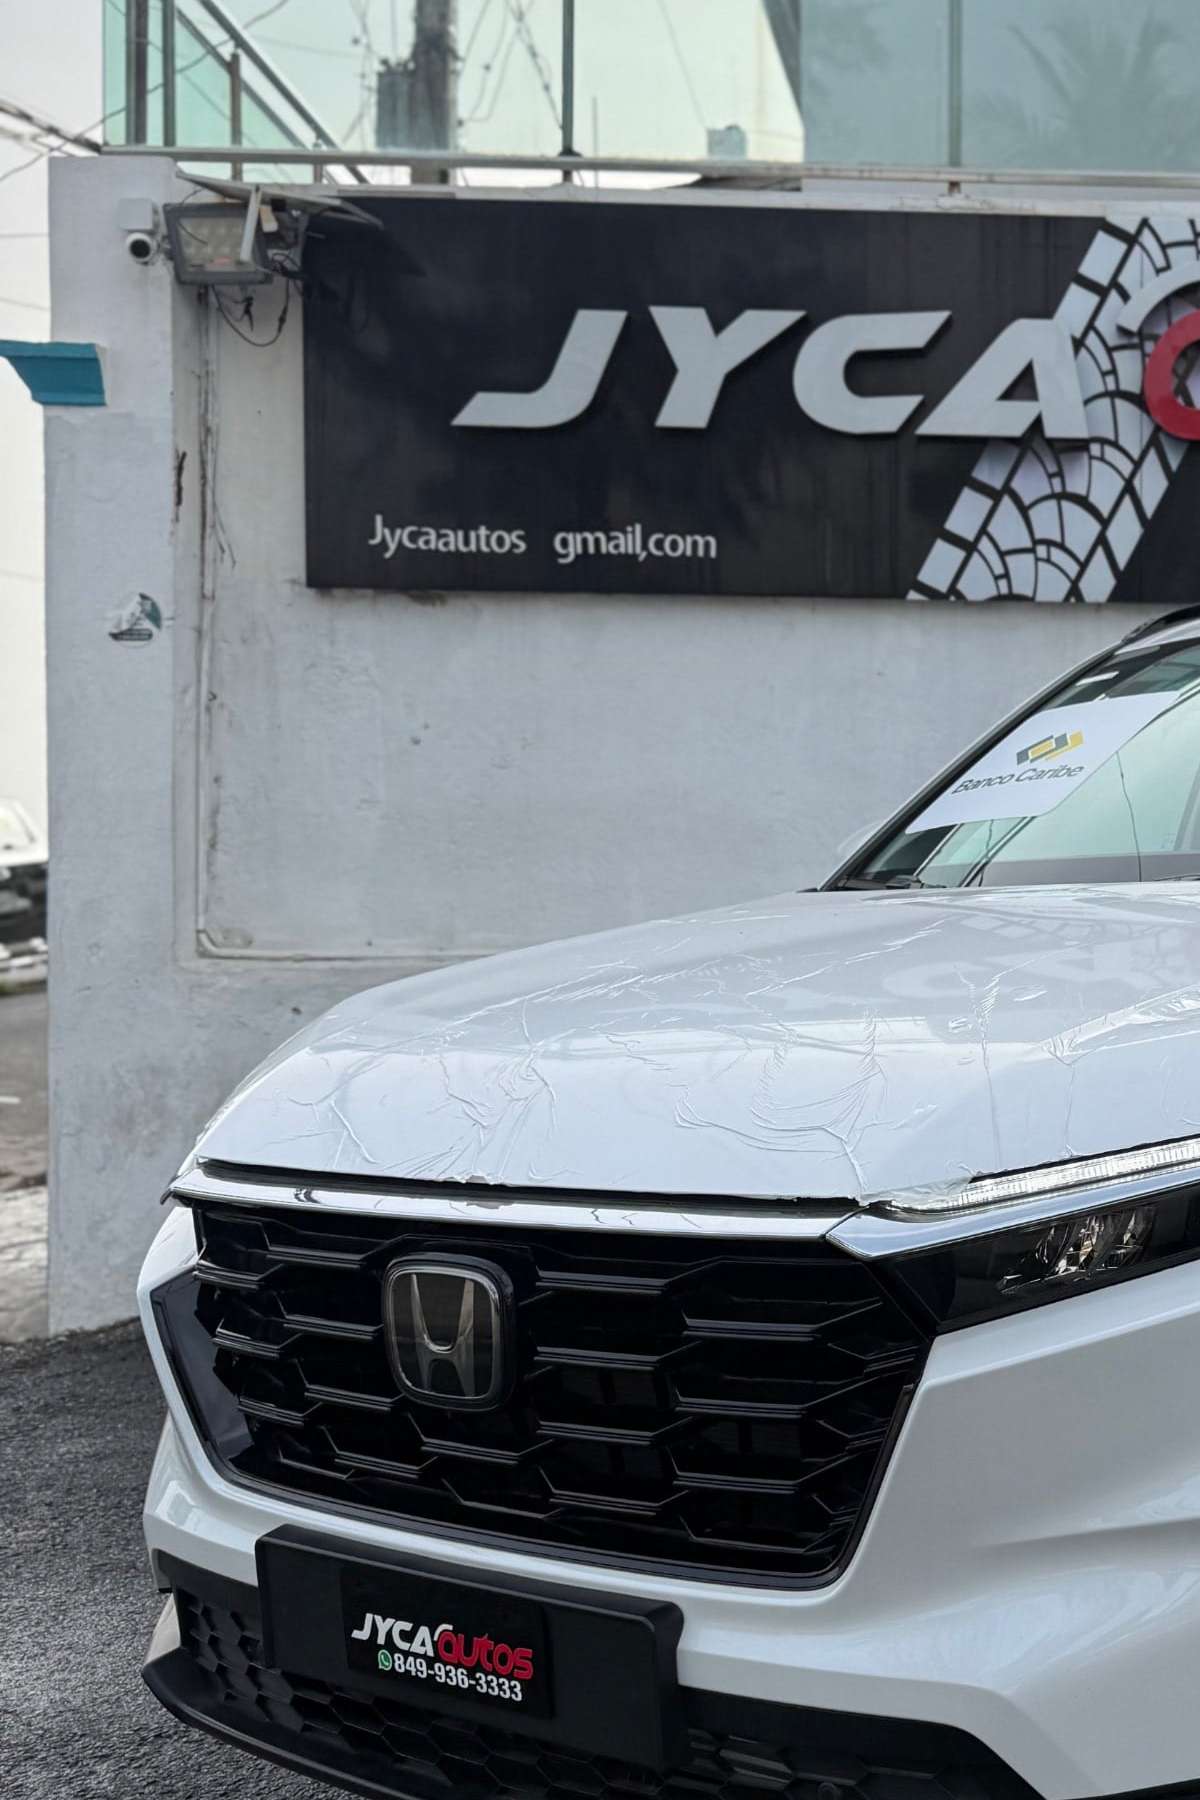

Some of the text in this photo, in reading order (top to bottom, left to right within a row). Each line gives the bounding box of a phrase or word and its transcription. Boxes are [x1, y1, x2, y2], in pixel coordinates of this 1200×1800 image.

[450, 306, 1089, 438] JYCA
[368, 514, 527, 559] Jycaautos
[951, 764, 1085, 795] Banco Caribe
[351, 1613, 434, 1657] JYCA
[394, 1652, 523, 1702] 849-936-3333
